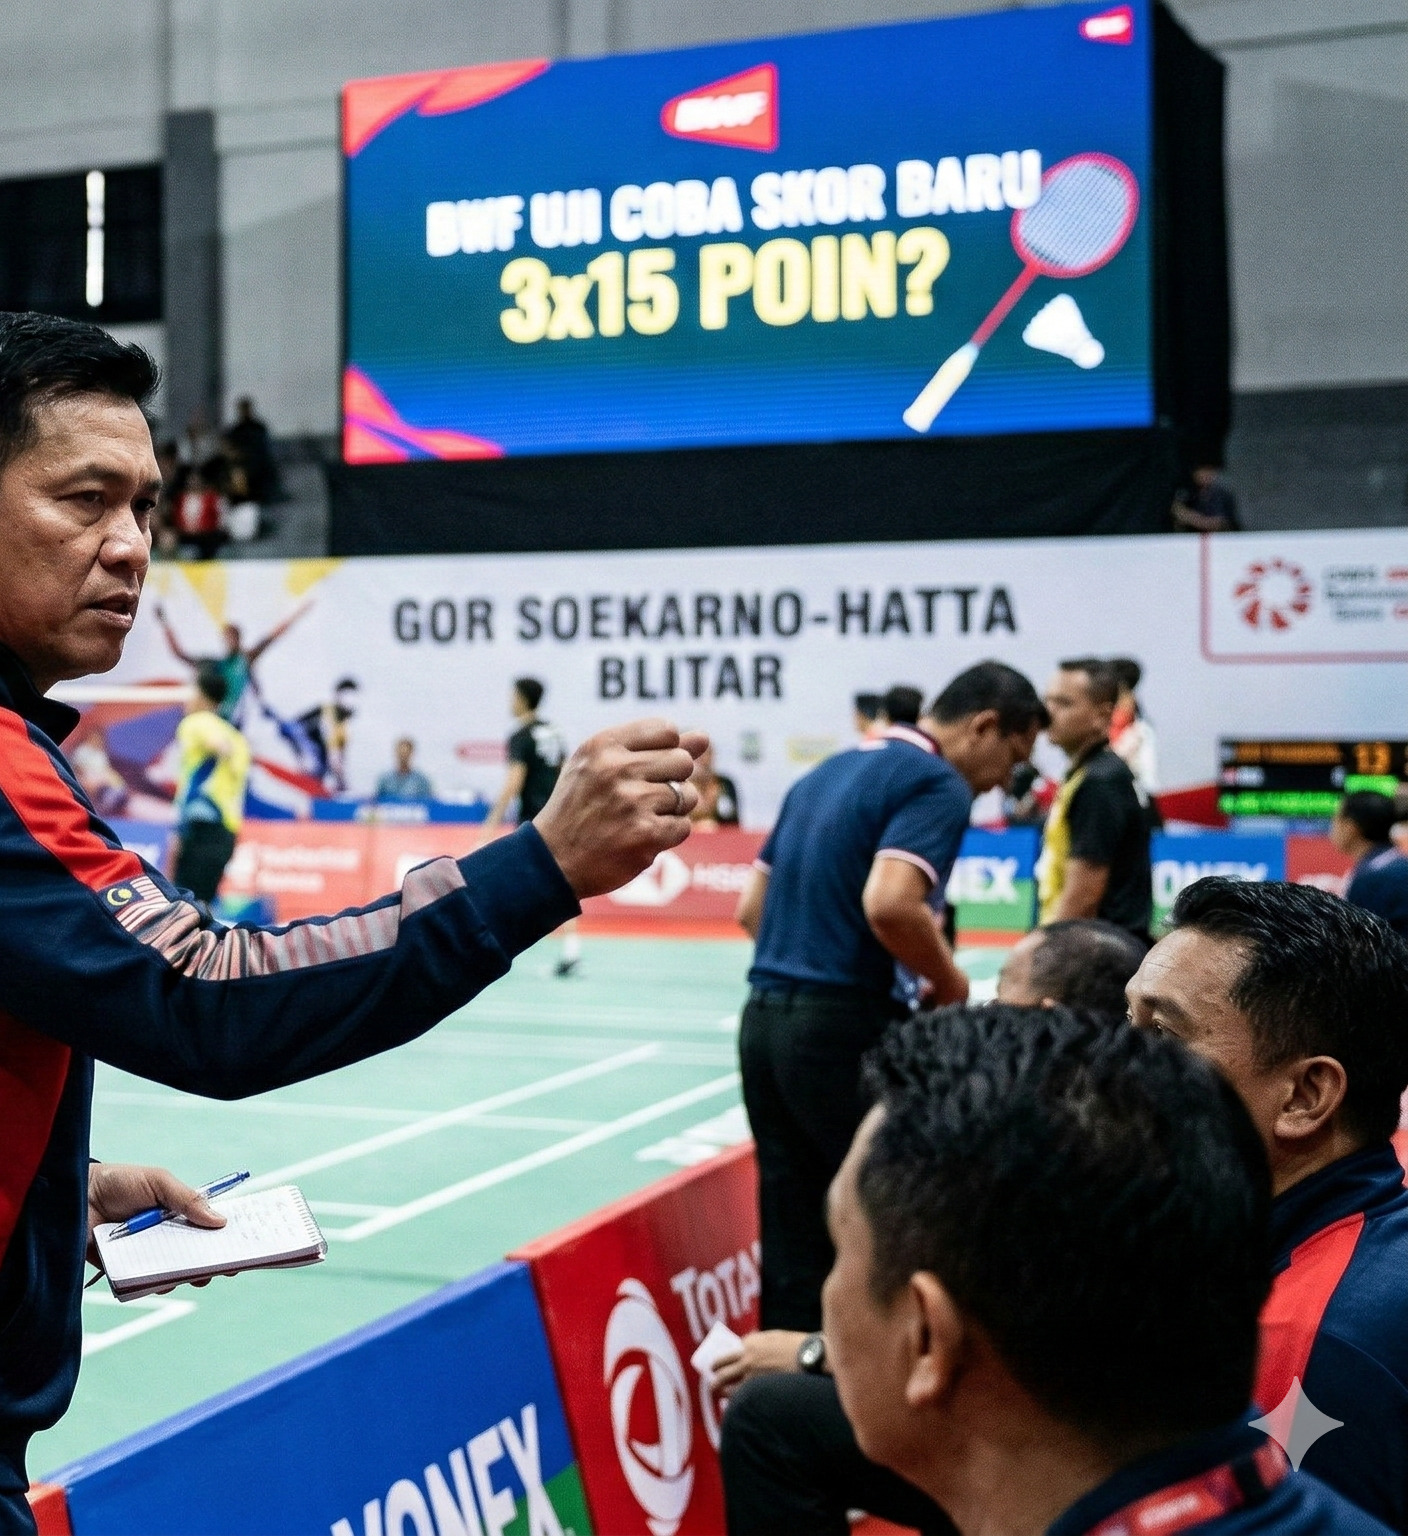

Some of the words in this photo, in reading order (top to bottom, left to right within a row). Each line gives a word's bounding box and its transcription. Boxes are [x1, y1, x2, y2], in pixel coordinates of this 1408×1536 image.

[426, 194, 525, 257] BWF
[530, 187, 602, 248] UJI
[610, 176, 743, 241] COBA
[750, 163, 887, 230] SKOR
[896, 149, 1042, 218] BARU
[500, 247, 680, 344] 3x15
[699, 226, 951, 331] POIN?
[393, 597, 494, 643] GOR
[517, 585, 1018, 640] SOEKARNO-HATTA
[598, 654, 783, 700] BLITAR
[669, 1240, 762, 1343] TOTA
